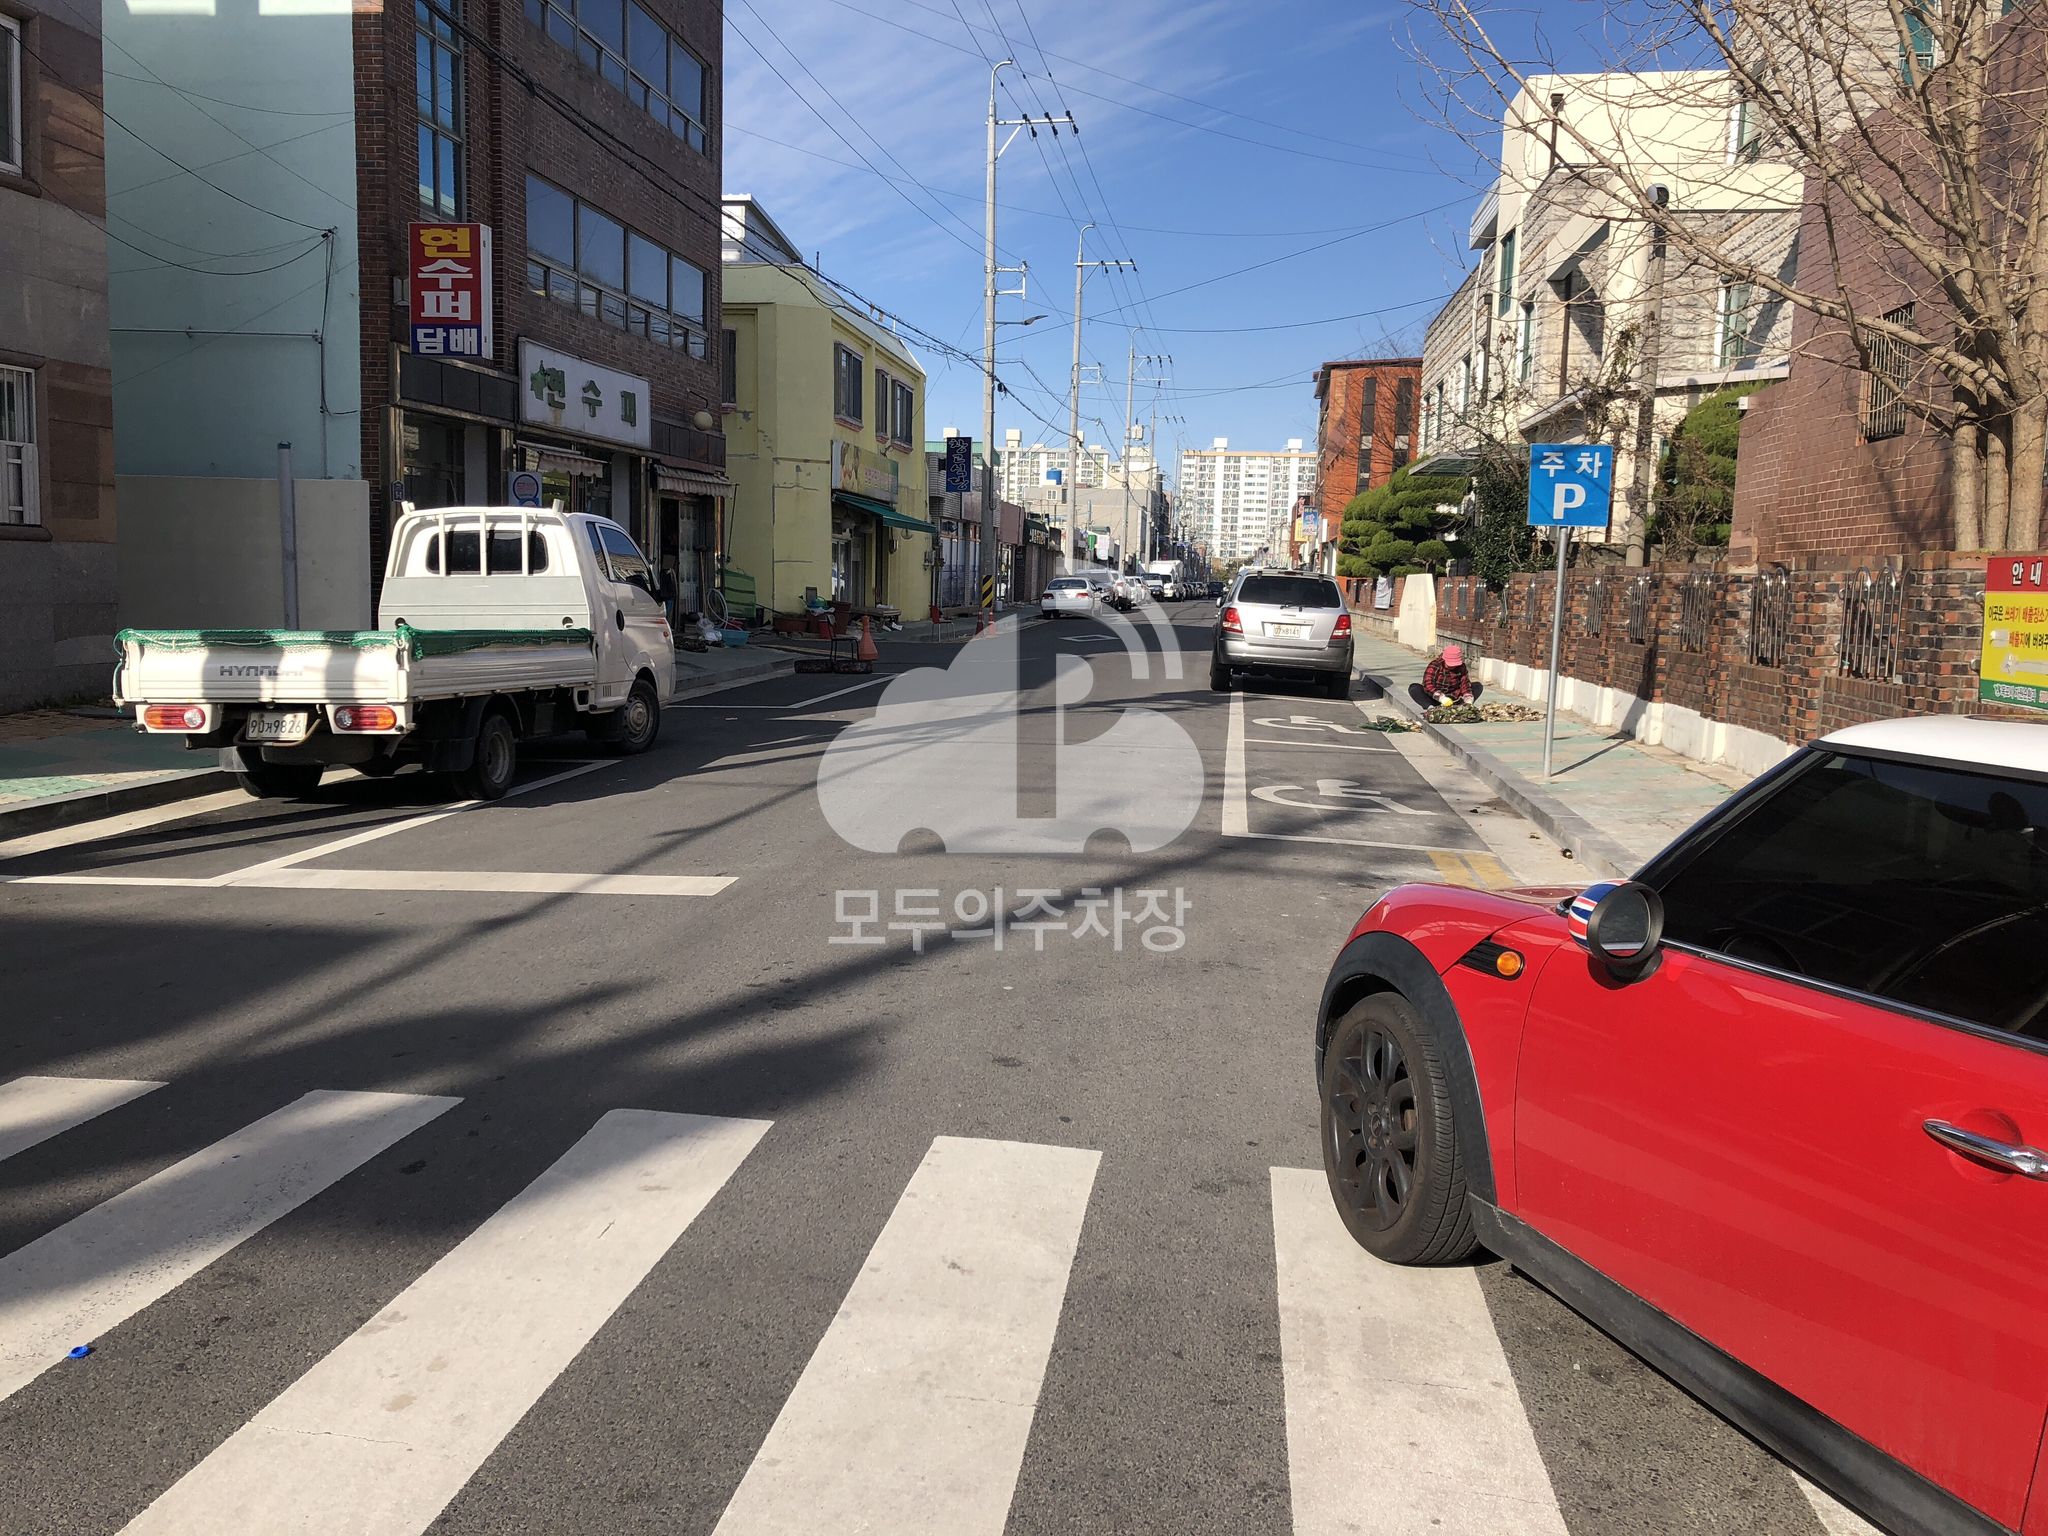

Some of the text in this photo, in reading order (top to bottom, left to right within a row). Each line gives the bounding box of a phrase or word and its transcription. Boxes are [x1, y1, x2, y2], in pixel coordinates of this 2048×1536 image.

[417, 227, 473, 322] 현수퍼
[416, 327, 479, 355] 담배
[1539, 451, 1603, 478] 주차
[1552, 482, 1586, 520] P
[2012, 560, 2048, 587] 안내
[1988, 605, 2004, 621] 이곳은
[2004, 606, 2021, 622] 쓰레기
